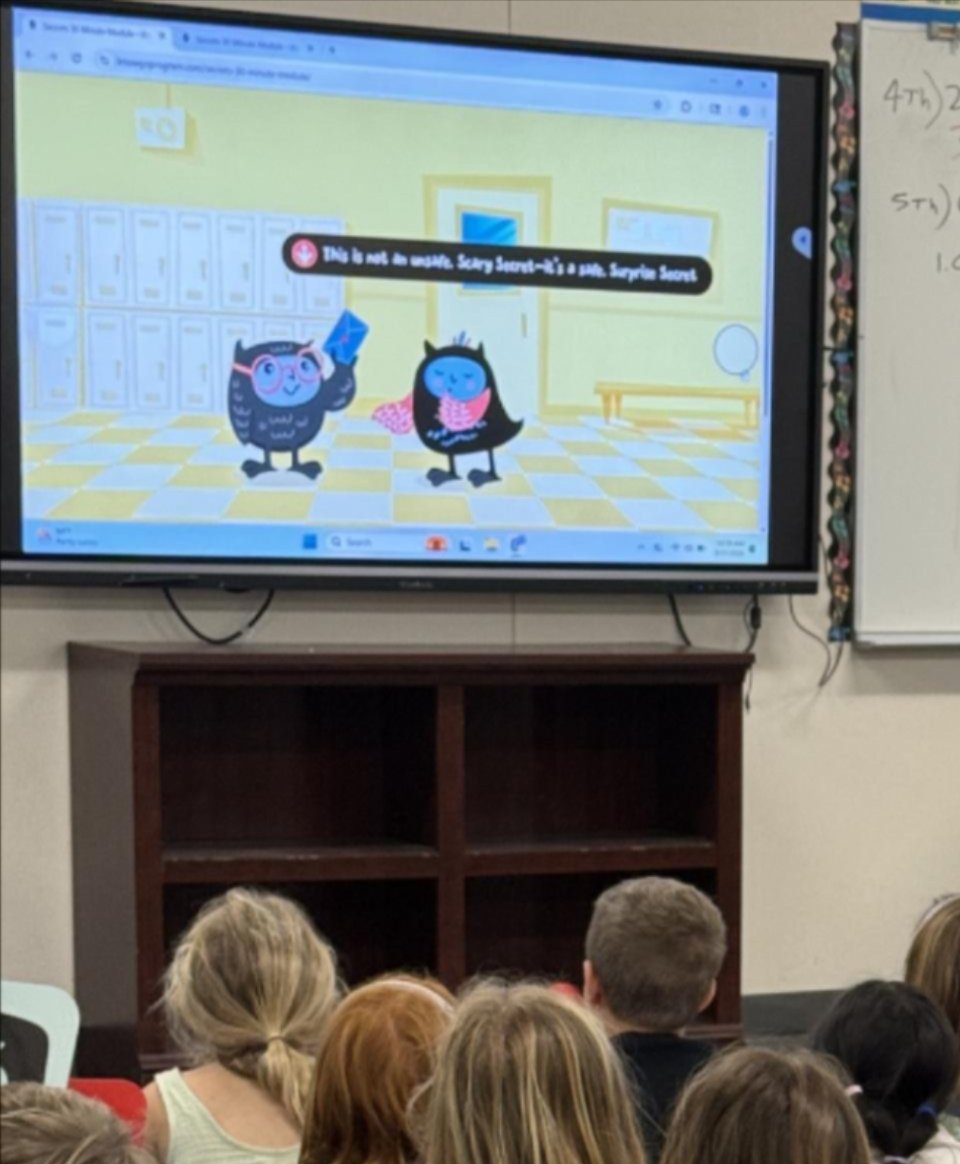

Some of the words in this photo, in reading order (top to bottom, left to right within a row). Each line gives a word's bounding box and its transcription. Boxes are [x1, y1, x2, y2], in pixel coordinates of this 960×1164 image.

[322, 245, 348, 264] This
[351, 246, 363, 266] is
[659, 264, 698, 283] Secret
